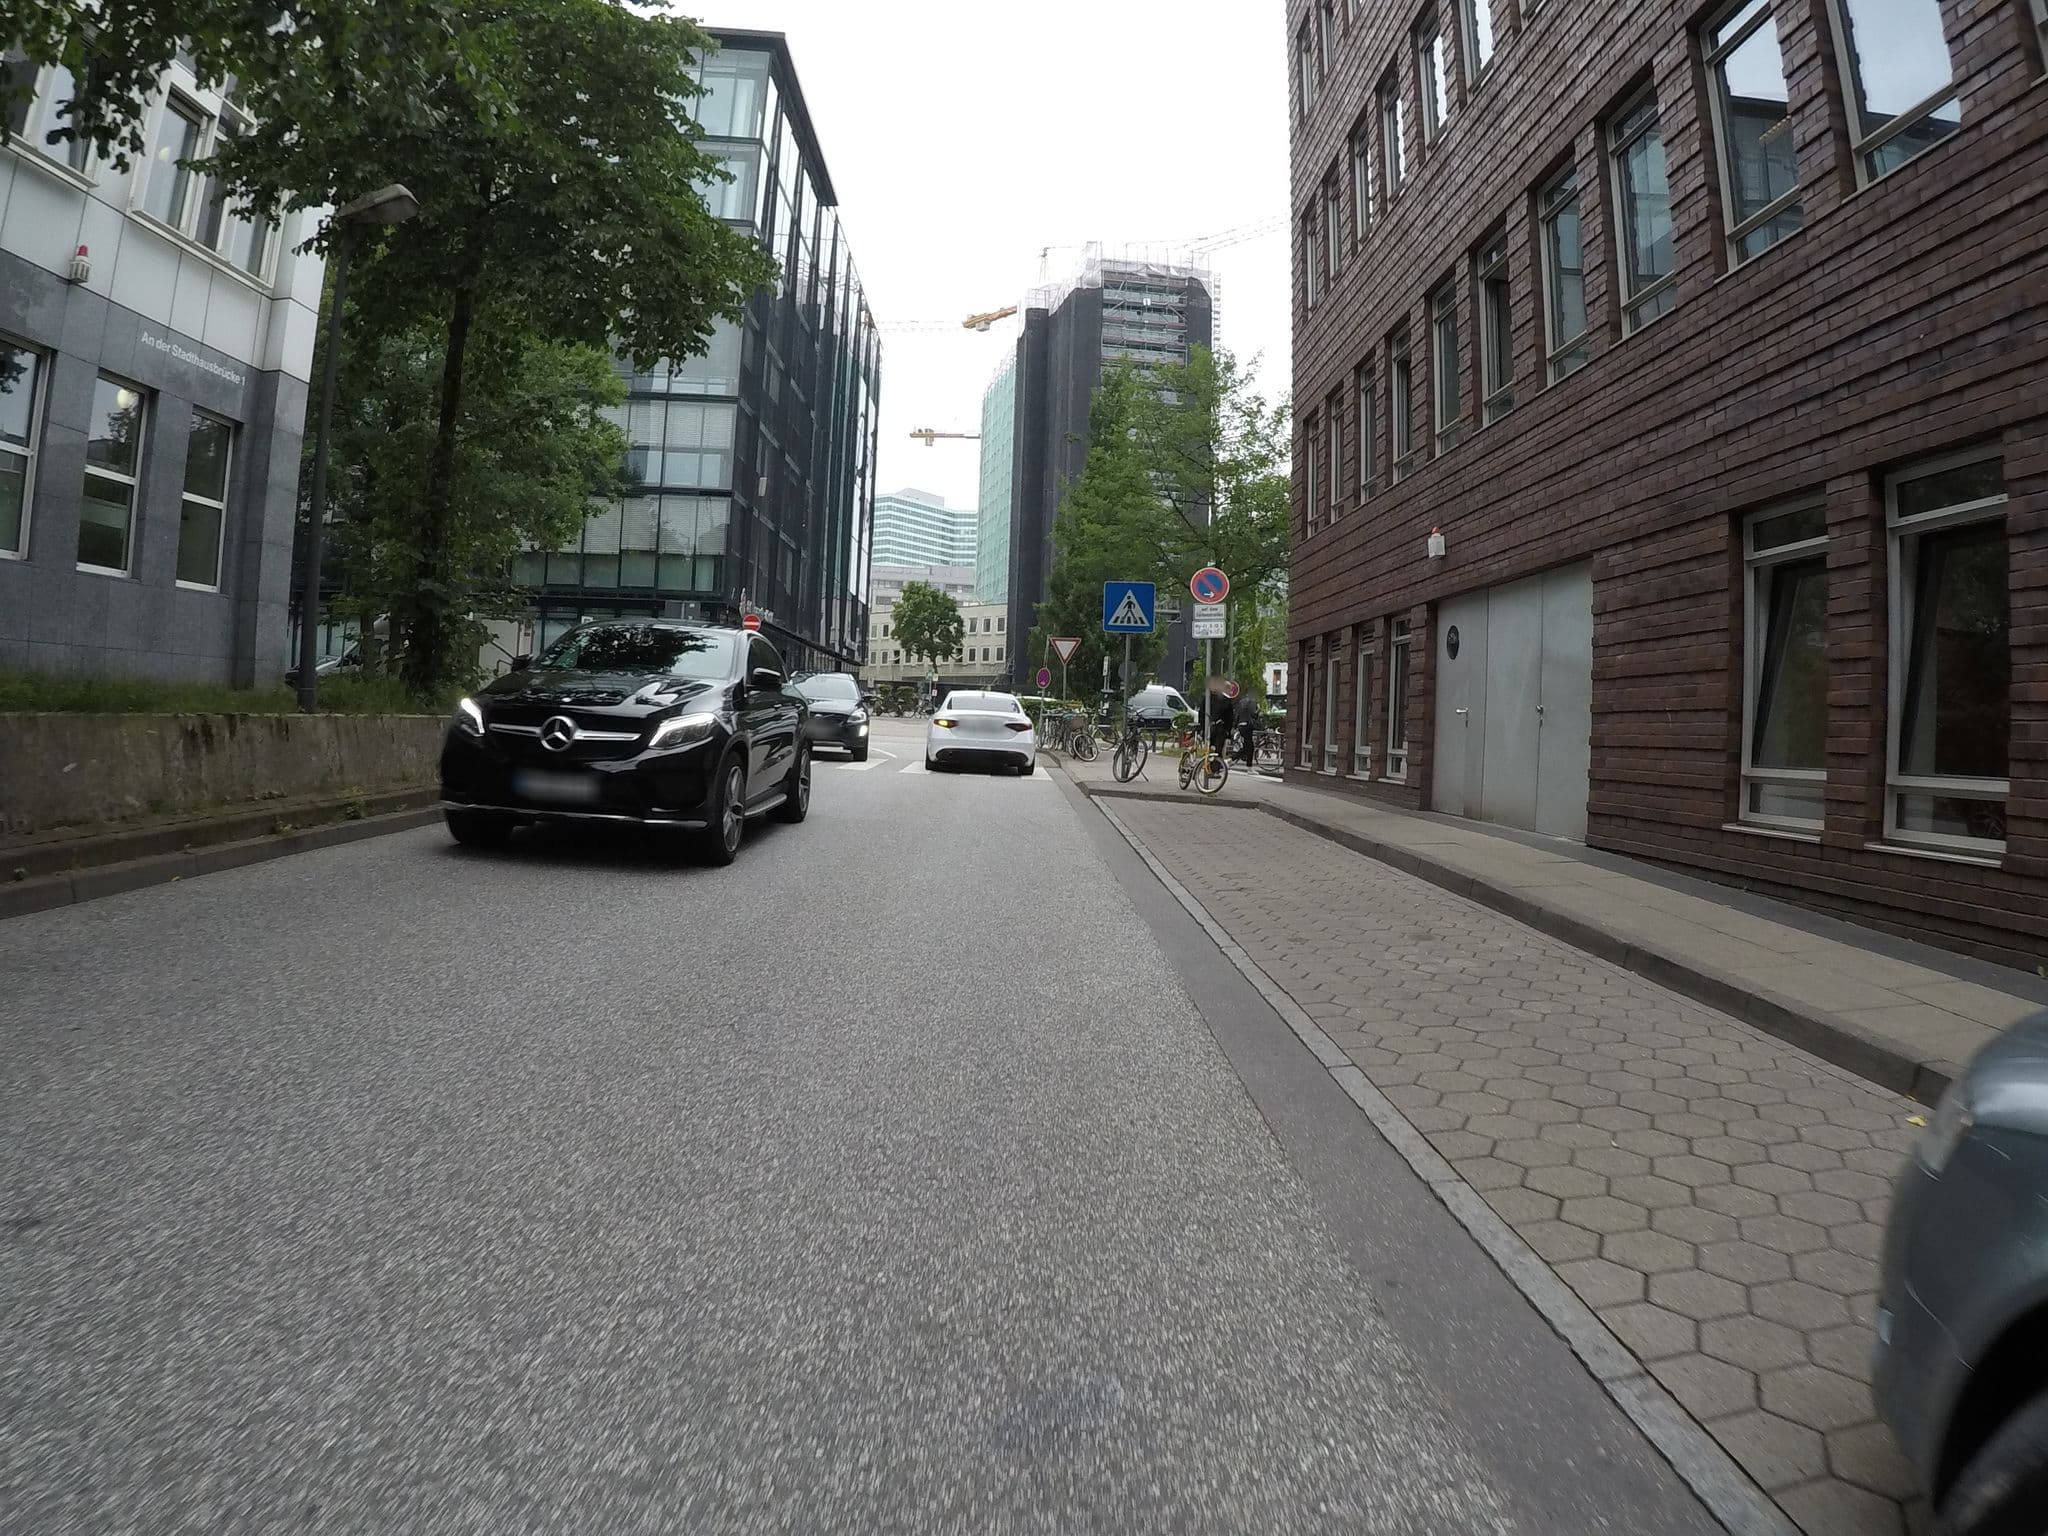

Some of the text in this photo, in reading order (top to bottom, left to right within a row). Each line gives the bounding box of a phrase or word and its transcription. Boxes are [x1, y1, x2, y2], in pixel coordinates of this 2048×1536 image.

[141, 331, 155, 347] An
[155, 338, 171, 353] der
[172, 344, 241, 384] Stadthausbrücke
